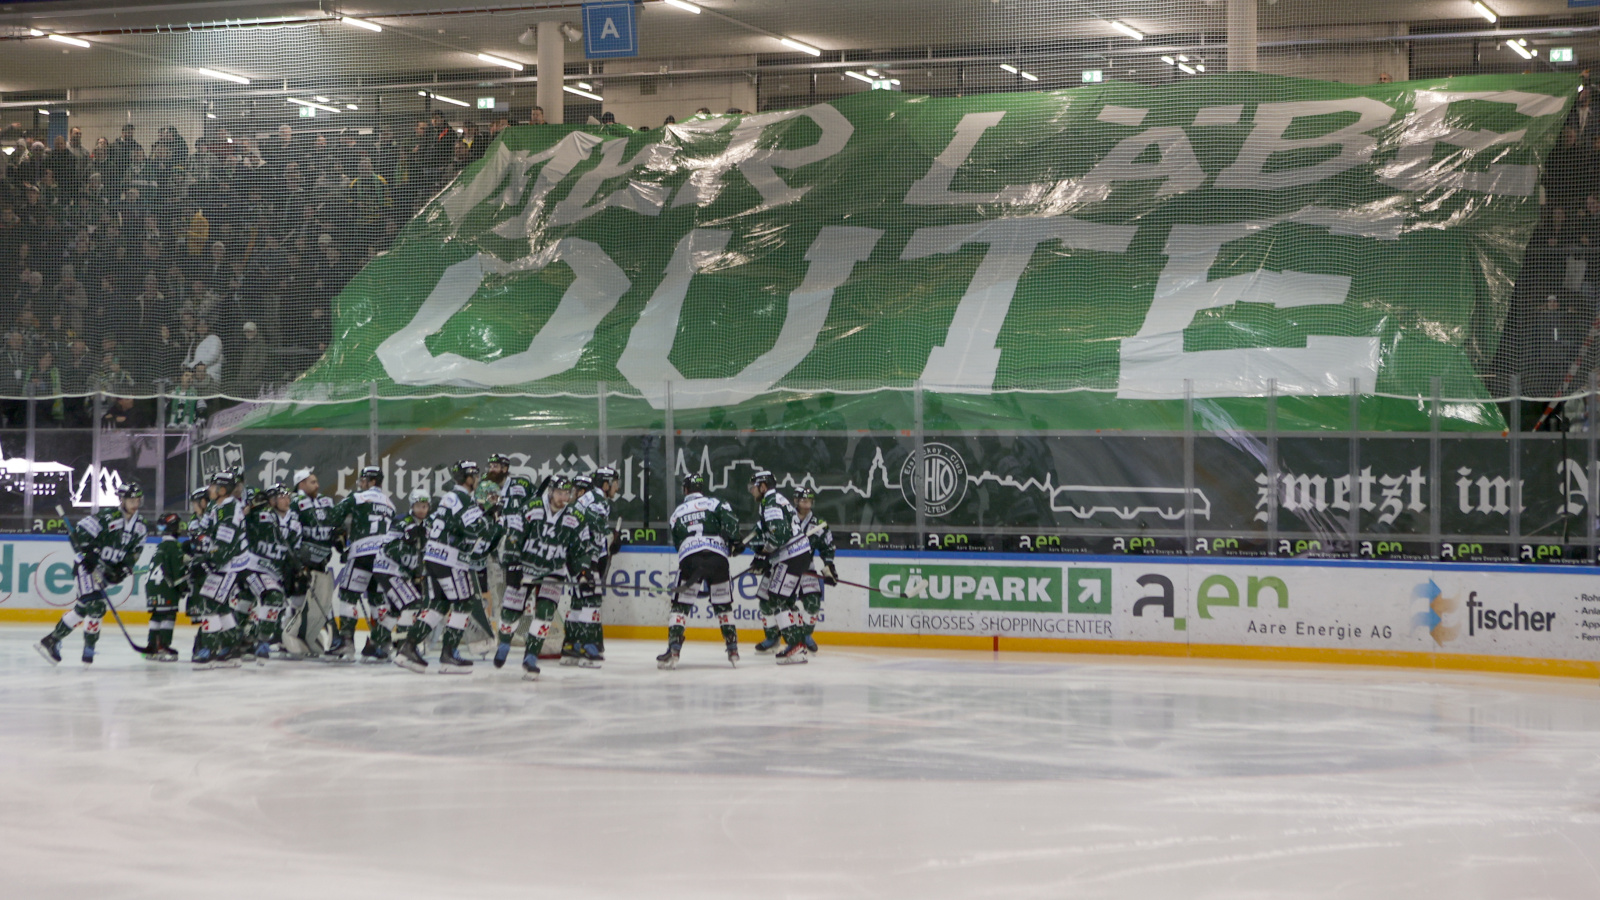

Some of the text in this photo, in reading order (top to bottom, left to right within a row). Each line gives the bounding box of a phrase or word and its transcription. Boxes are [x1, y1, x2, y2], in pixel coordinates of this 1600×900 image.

[600, 17, 621, 39] A
[374, 206, 1402, 410] OUTE
[1455, 465, 1527, 516] im
[878, 568, 1052, 602] GÄUPARK
[868, 613, 1112, 634] MEIN GROSSES SHOPPINGCENTER
[1247, 619, 1393, 641] Aare Energie AG
[1466, 591, 1556, 636] fischer
